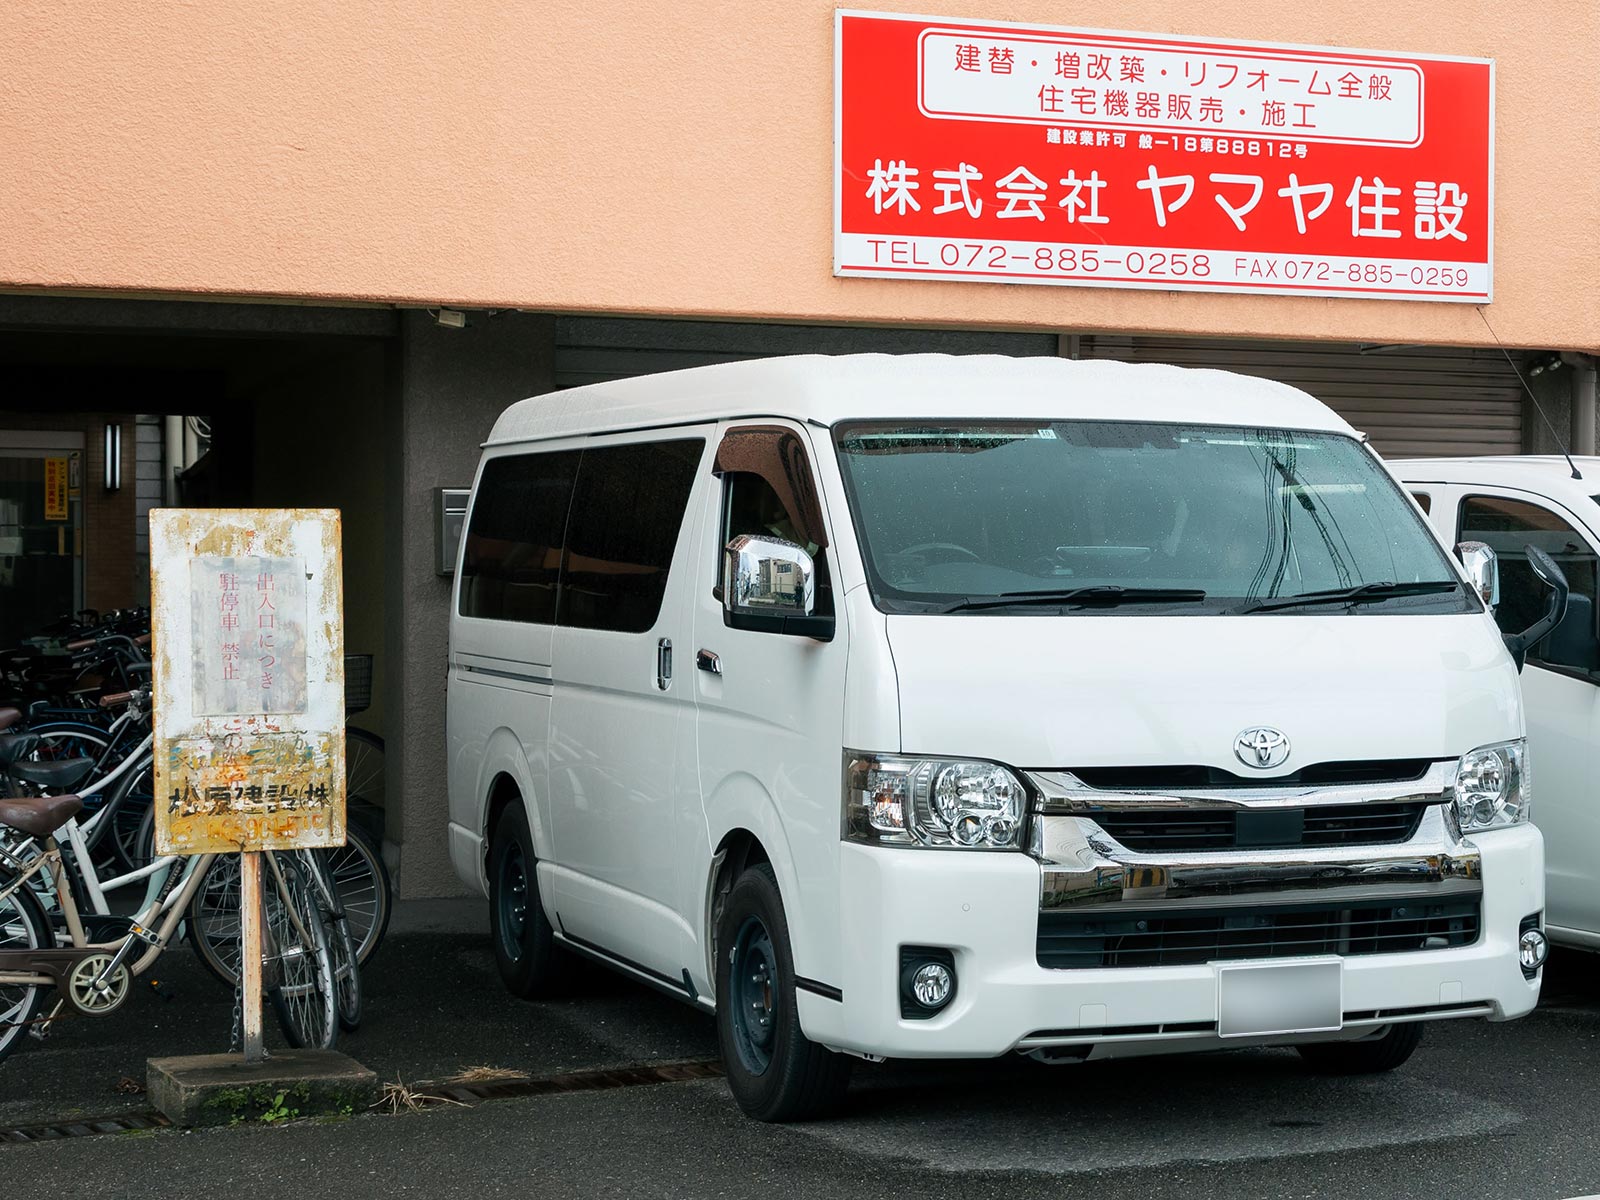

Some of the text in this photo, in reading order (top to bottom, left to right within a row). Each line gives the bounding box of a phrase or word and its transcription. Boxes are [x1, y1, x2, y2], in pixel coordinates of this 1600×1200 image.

[954, 43, 1393, 101] 建替・増改築・リフォーム全般
[1037, 84, 1317, 129] 住宅機器販売・施工
[1046, 128, 1127, 148] 建設業許可
[866, 158, 1469, 243] 株式会社 ヤマヤ住設
[867, 240, 1211, 277] TEL 072-885-0258
[1235, 258, 1468, 287] FAX 072-885-0259
[219, 573, 240, 680] 駐停車 禁止
[257, 572, 275, 689] 出入口につき
